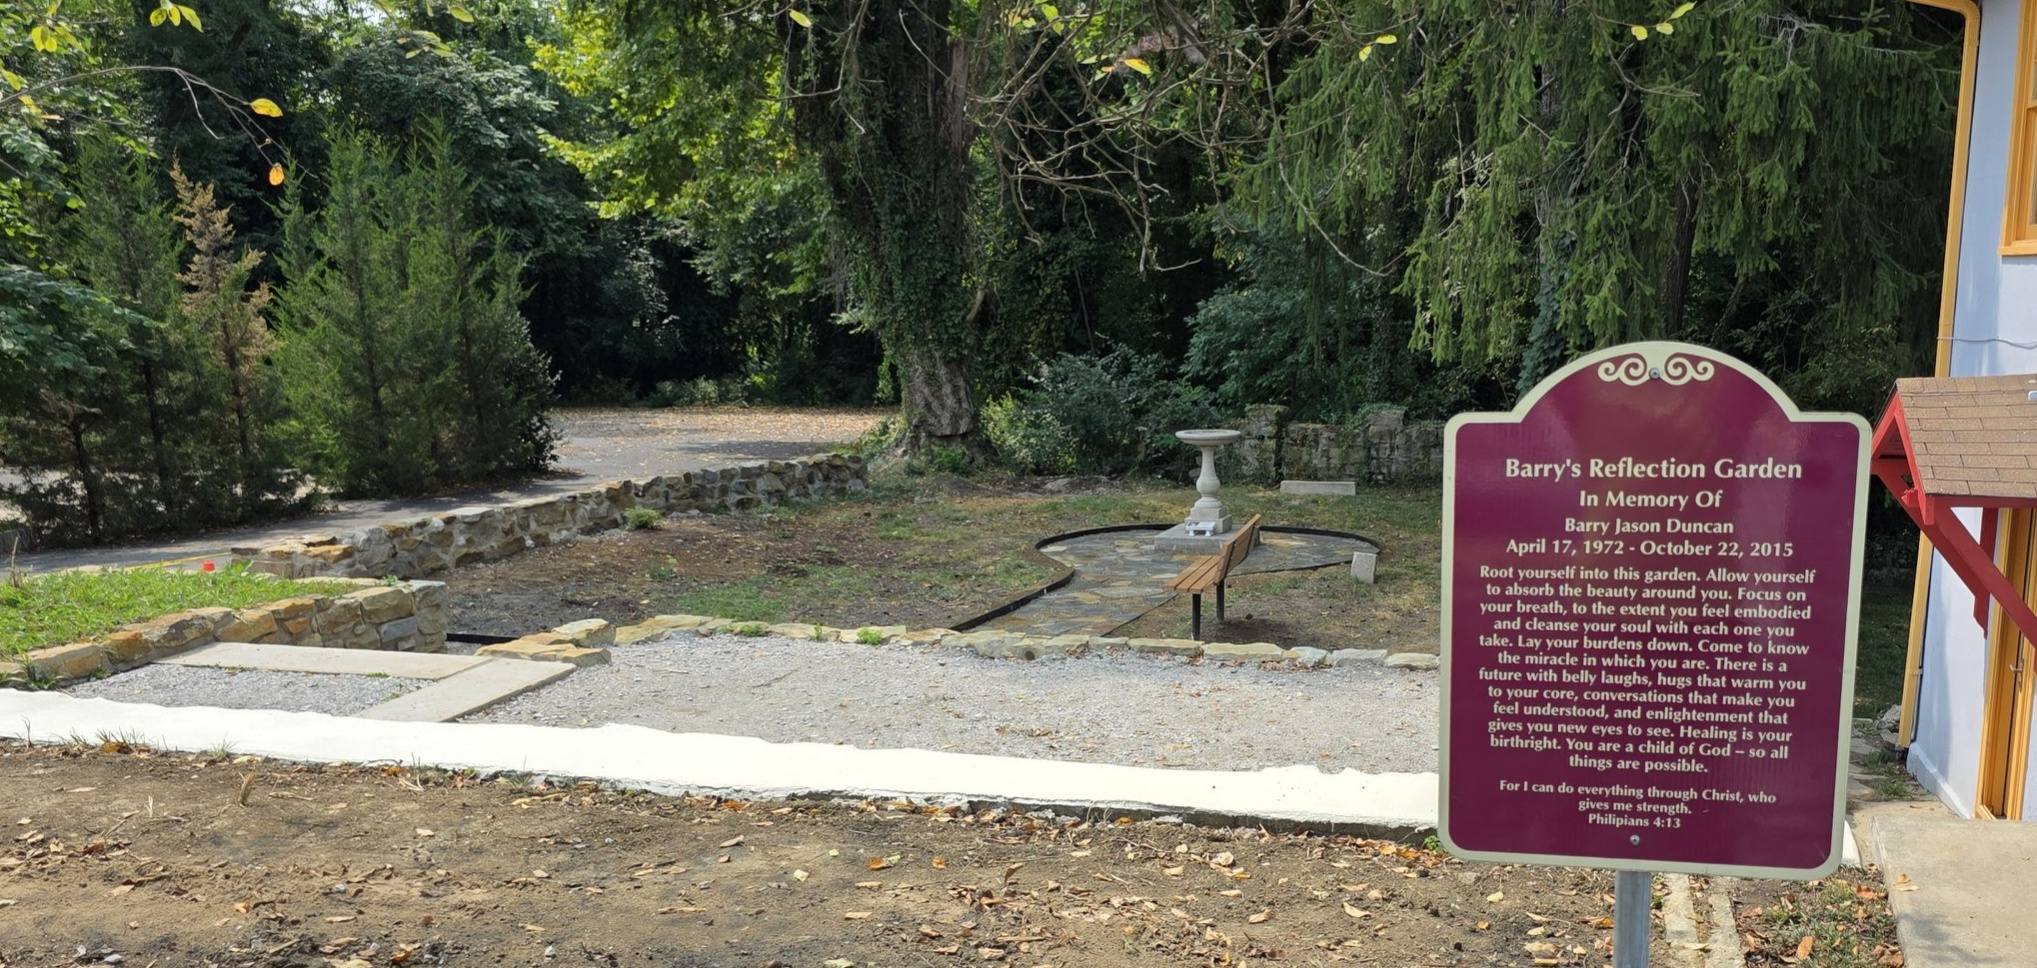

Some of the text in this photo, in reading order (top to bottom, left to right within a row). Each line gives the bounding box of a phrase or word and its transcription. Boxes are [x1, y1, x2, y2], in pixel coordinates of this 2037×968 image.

[1506, 456, 1802, 482] Barry's Reflection Garden
[1580, 489, 1723, 511] In Memory Of
[1565, 517, 1734, 536] Barry Jason Duncan
[1506, 538, 1546, 557] April
[1552, 539, 1577, 556] 17,
[1583, 540, 1624, 554] 1972
[1640, 539, 1713, 556] October
[1717, 541, 1744, 559] 22,
[1750, 542, 1793, 557] 2015
[1480, 565, 1816, 585] Root yourself into this garden. Allow yourself
[1486, 582, 1806, 602] to absorb the beauty around you. Focus on
[1480, 599, 1811, 619] your breath, to the extent you feel embodied
[1493, 616, 1795, 639] and cleanse your soul with each one you
[1479, 633, 1810, 655] take. Lay your burdens down. Come to know
[1498, 650, 1787, 672] the miracle in which you are. There is a
[1479, 667, 1806, 693] future with belly laughs, hugs that warm you
[1488, 685, 1795, 709] to your core, conversations that make you
[1493, 700, 1788, 725] feel understood, and enlightenment that
[1488, 718, 1792, 744] gives you new eyes to see. Healing is your
[1490, 734, 1561, 752] birthright.
[1566, 738, 1593, 751] You
[1597, 742, 1621, 752] are
[1625, 743, 1634, 753] a
[1638, 740, 1675, 754] child
[1679, 741, 1695, 755] of
[1699, 743, 1731, 757] God
[1749, 748, 1766, 758] so
[1770, 745, 1788, 759] all
[1569, 754, 1708, 773] things are possible.
[1500, 780, 1776, 803] For I can do everything through Christ, who
[1578, 798, 1692, 816] gives me strength.
[1588, 813, 1681, 828] Philipians 4:13
